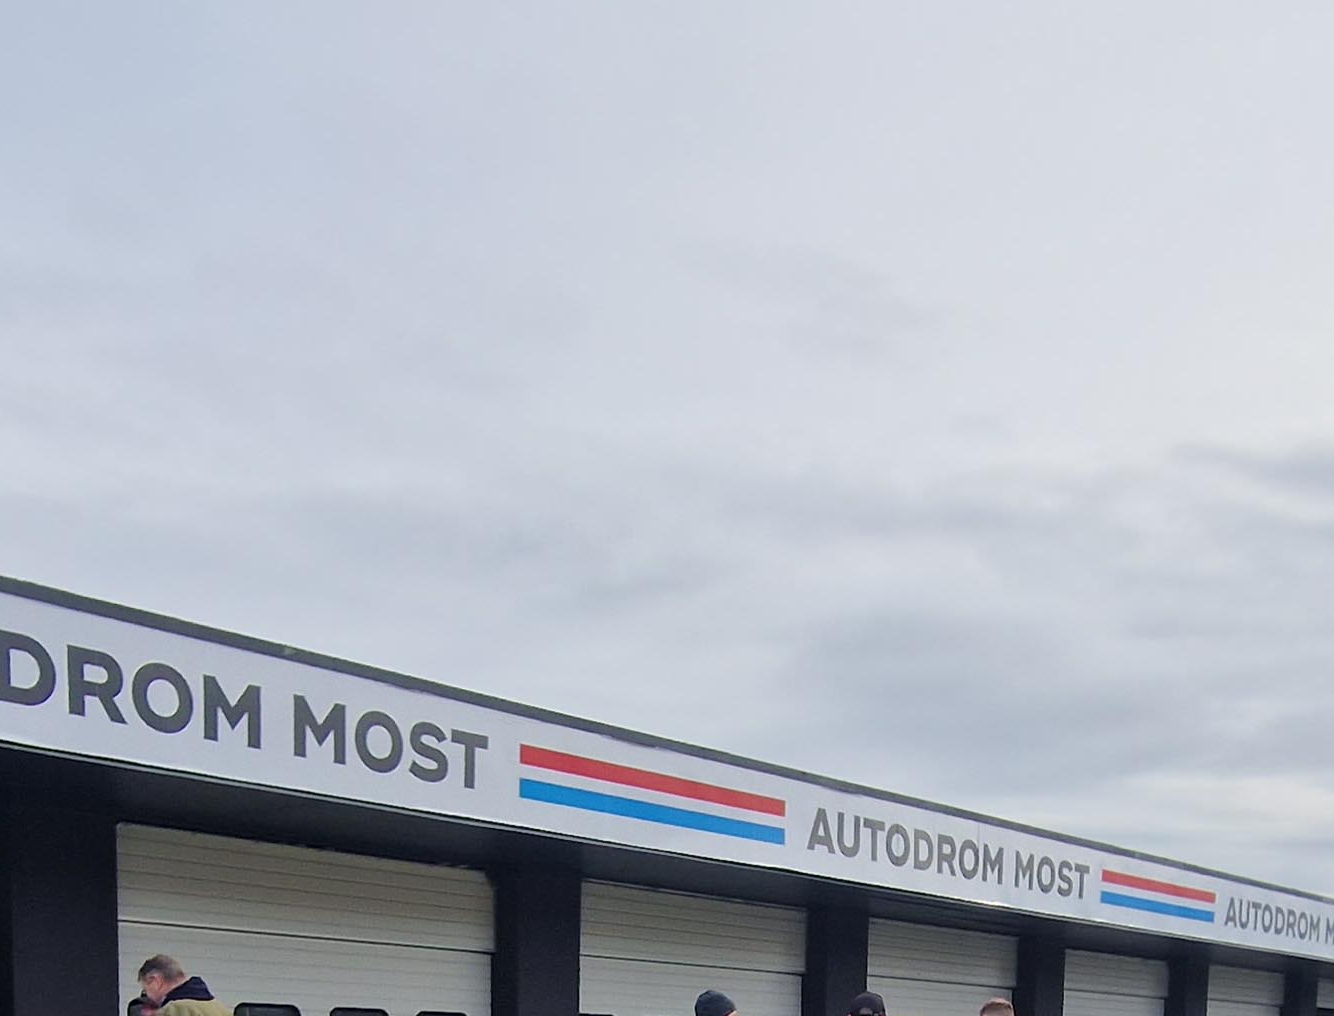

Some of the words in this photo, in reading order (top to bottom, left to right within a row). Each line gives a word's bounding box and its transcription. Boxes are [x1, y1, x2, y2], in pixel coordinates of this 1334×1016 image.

[293, 694, 489, 789] MOST
[807, 808, 1005, 885] AUTODROM
[1014, 850, 1090, 899] MOST
[1224, 898, 1321, 942] AUTODROM
